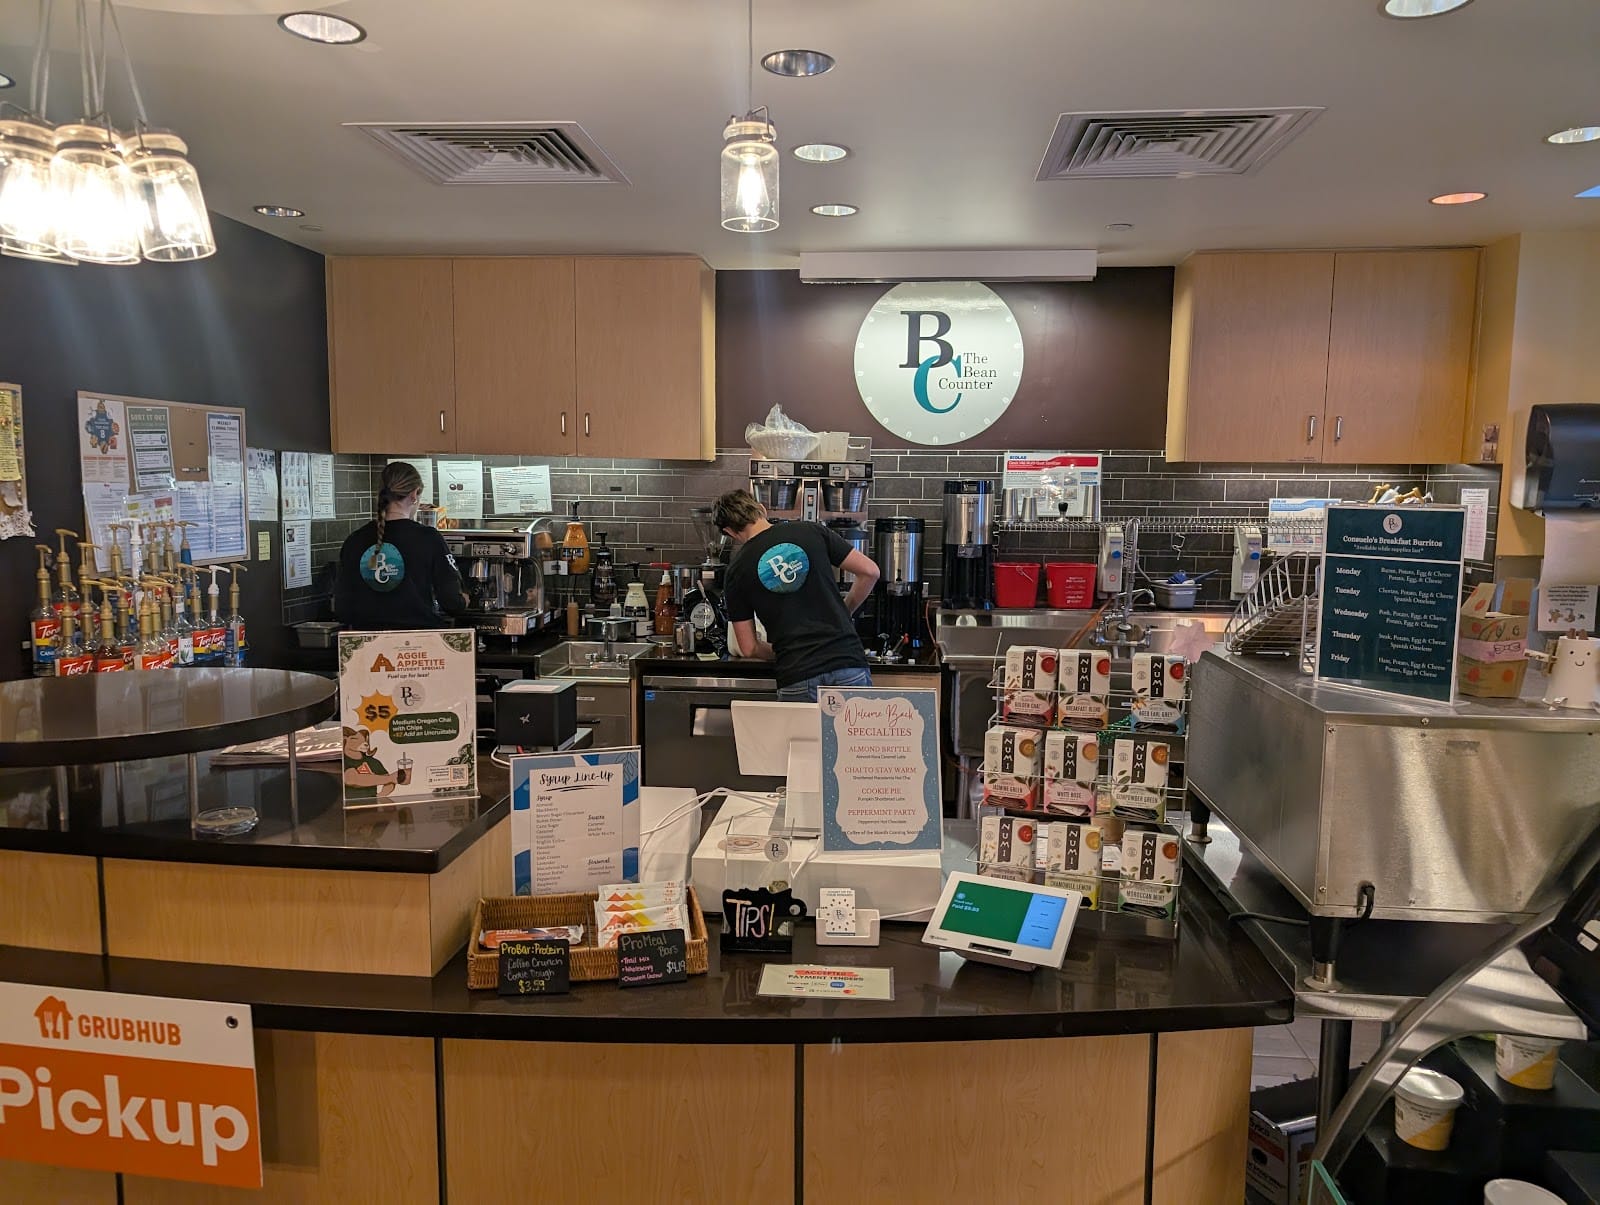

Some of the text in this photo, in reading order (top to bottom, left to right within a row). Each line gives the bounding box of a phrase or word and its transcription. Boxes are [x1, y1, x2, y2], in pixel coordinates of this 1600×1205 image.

[963, 353, 988, 364] The
[963, 366, 997, 378] Bean
[939, 378, 992, 390] Counter
[1343, 535, 1378, 543] Consuelo's
[1379, 537, 1411, 546] Breakfast
[1336, 567, 1361, 576] Monday
[1335, 587, 1360, 596] Tuesday
[1334, 608, 1369, 619] Wednesday
[1332, 631, 1360, 641] Thursday
[397, 659, 445, 667] APPETITE
[1331, 654, 1350, 663] Friday
[1025, 655, 1034, 687] NUMI
[1080, 658, 1089, 690] NUMI
[1152, 662, 1163, 695] NUMI
[365, 704, 391, 722] $5
[844, 703, 913, 727] Welcome Back
[848, 728, 912, 737] SPECIALTIES
[1003, 738, 1013, 770] NUMI
[1065, 743, 1075, 775] NUMI
[1135, 744, 1144, 778] NUMI
[540, 770, 614, 786] Syrup Line-Up
[1000, 823, 1010, 857] NUMI
[1067, 830, 1078, 865] NUMI
[1143, 839, 1154, 875] NUMI
[1050, 880, 1074, 890] CHAMOMILE
[1126, 890, 1150, 899] MOROCCAN
[726, 899, 775, 937] TIPS!
[660, 945, 679, 956] Bars
[532, 958, 563, 968] Crunch
[530, 969, 555, 982] Dough
[518, 980, 544, 994] $3.59
[78, 1014, 182, 1046] GRUBHUB
[0, 1065, 249, 1166] Pickup
